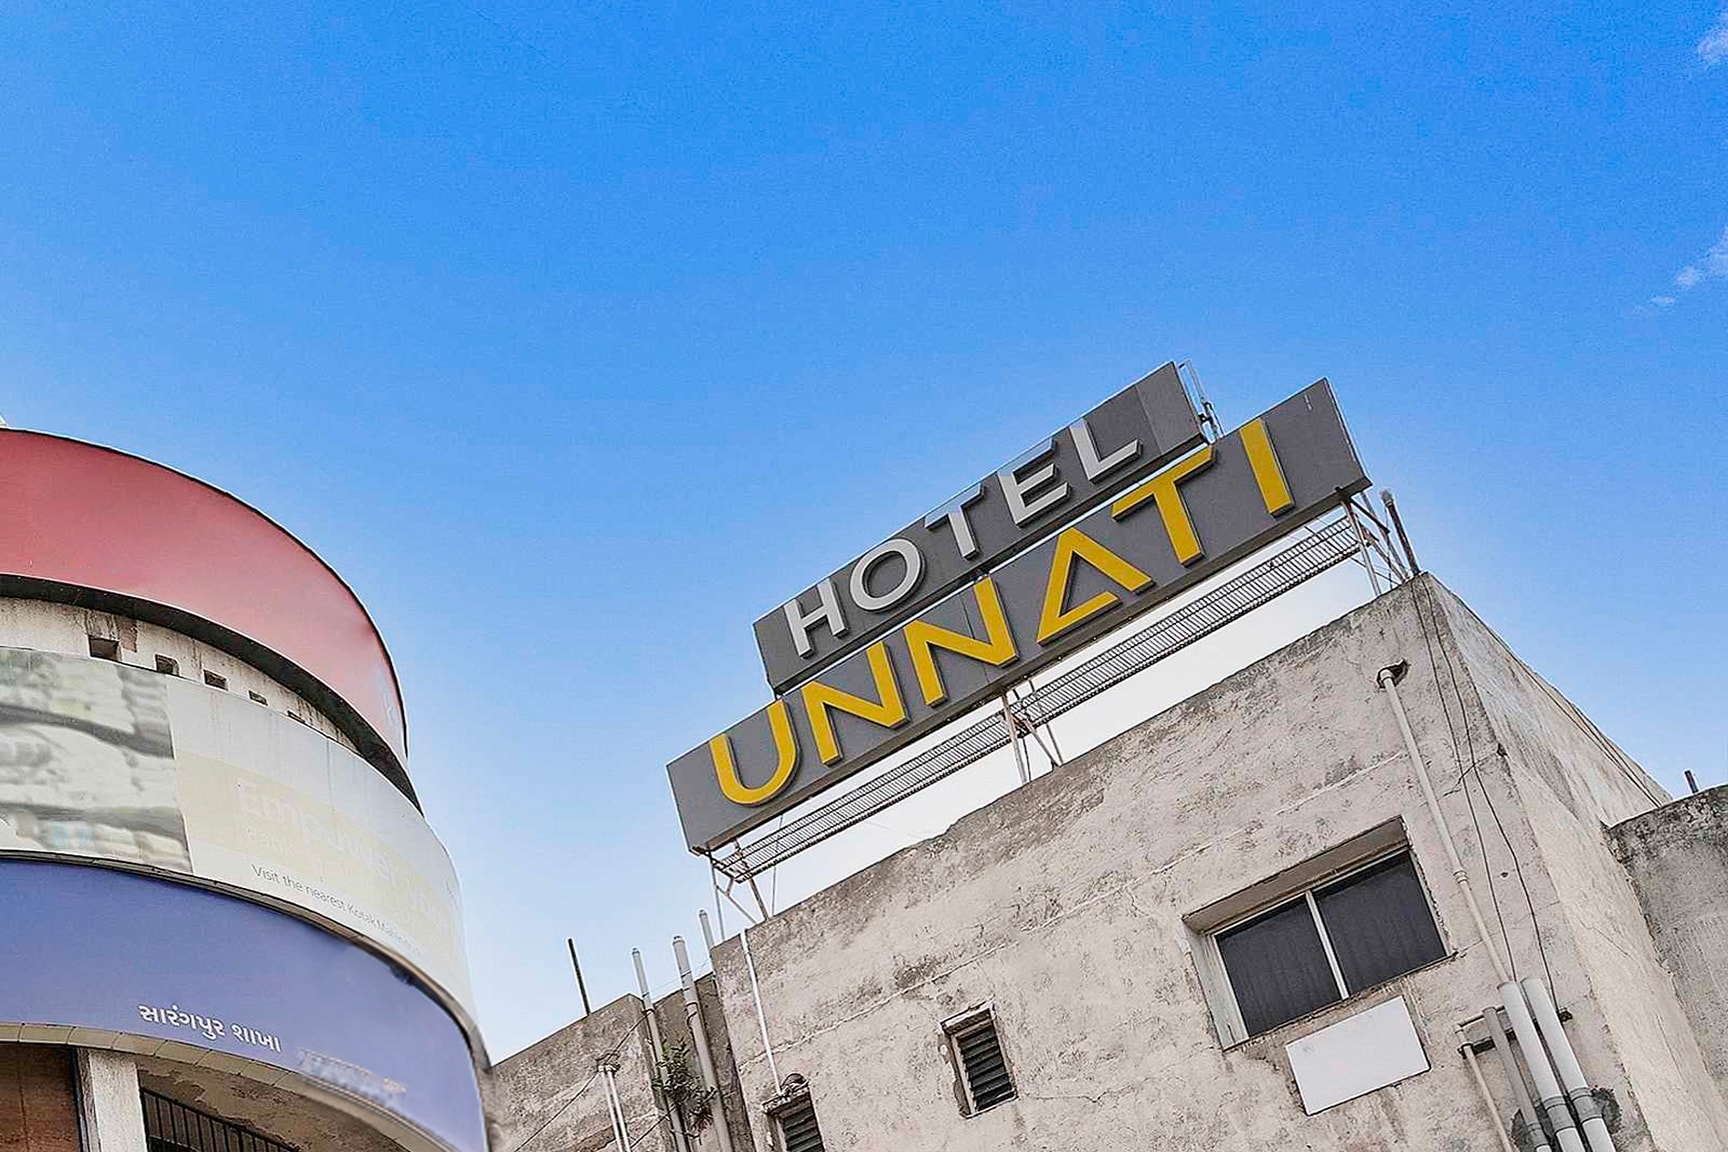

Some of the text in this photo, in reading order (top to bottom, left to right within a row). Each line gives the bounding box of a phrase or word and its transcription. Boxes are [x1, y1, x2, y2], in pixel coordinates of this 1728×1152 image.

[784, 418, 1142, 658] HOTEL
[709, 416, 1294, 806] UNNATI
[251, 864, 280, 884] Visit
[282, 875, 304, 891] the
[138, 1003, 226, 1040] સારંગપુર
